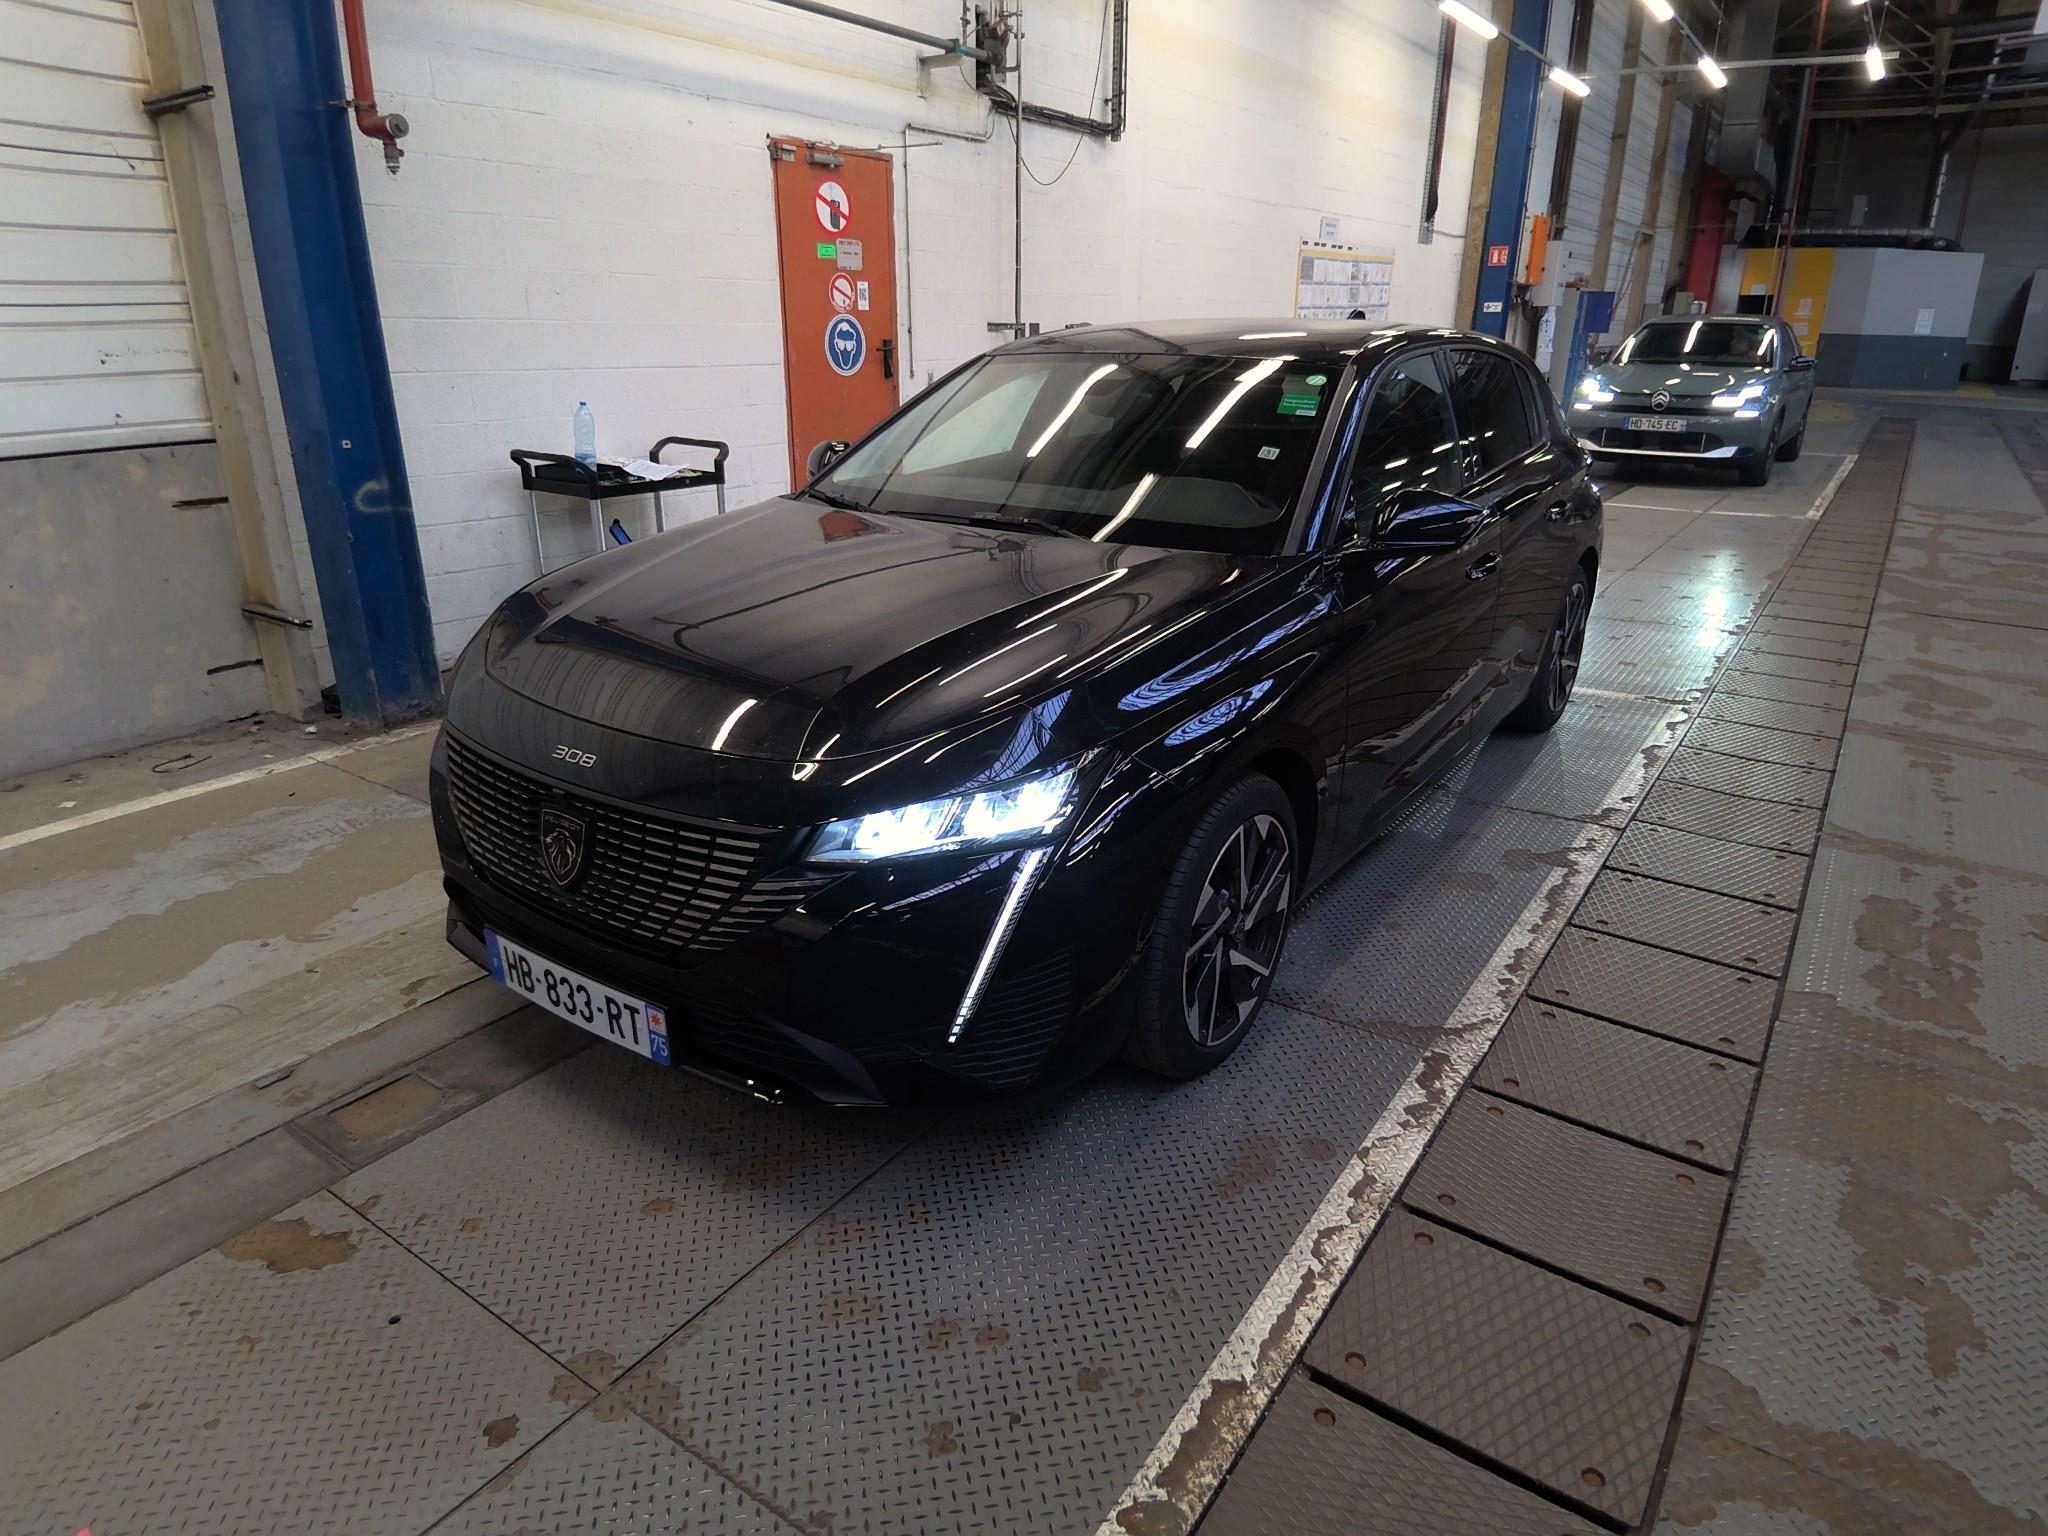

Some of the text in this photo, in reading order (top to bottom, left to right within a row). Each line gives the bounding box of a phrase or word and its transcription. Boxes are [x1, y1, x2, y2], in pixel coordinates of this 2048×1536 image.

[551, 744, 597, 768] 308
[544, 814, 581, 832] PEUGEOT
[503, 945, 640, 1046] HB-833-RT
[651, 1033, 668, 1057] 75
